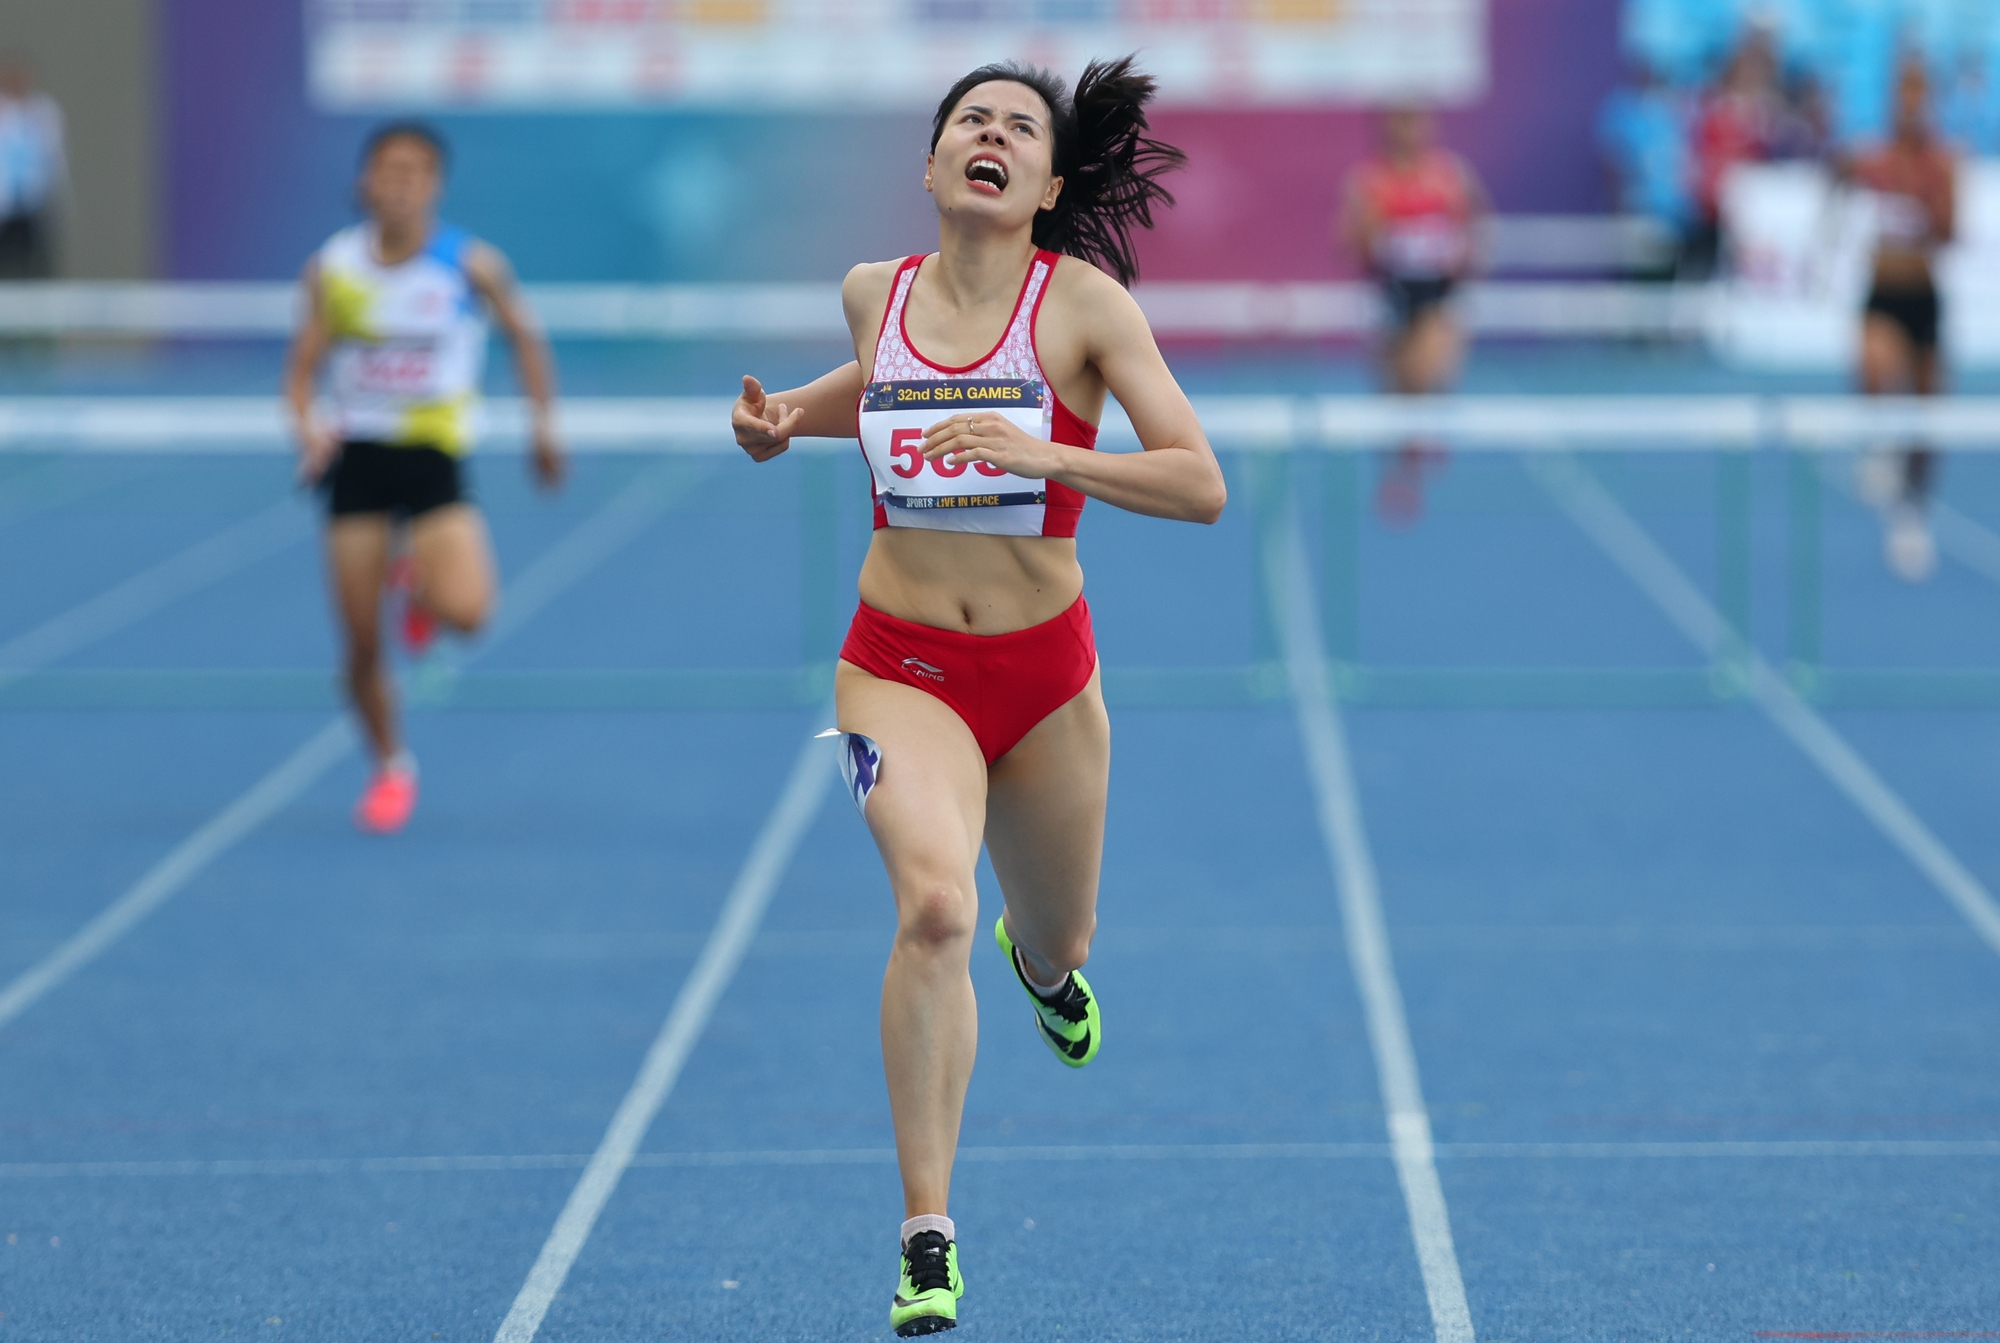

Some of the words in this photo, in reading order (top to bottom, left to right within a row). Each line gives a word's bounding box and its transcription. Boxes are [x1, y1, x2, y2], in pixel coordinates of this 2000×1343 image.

[897, 388, 930, 400] 32nd
[934, 387, 963, 400] SEA
[967, 386, 1022, 399] GAMES
[936, 497, 955, 508] LIVE
[958, 496, 968, 507] IN
[970, 495, 999, 506] PEACE
